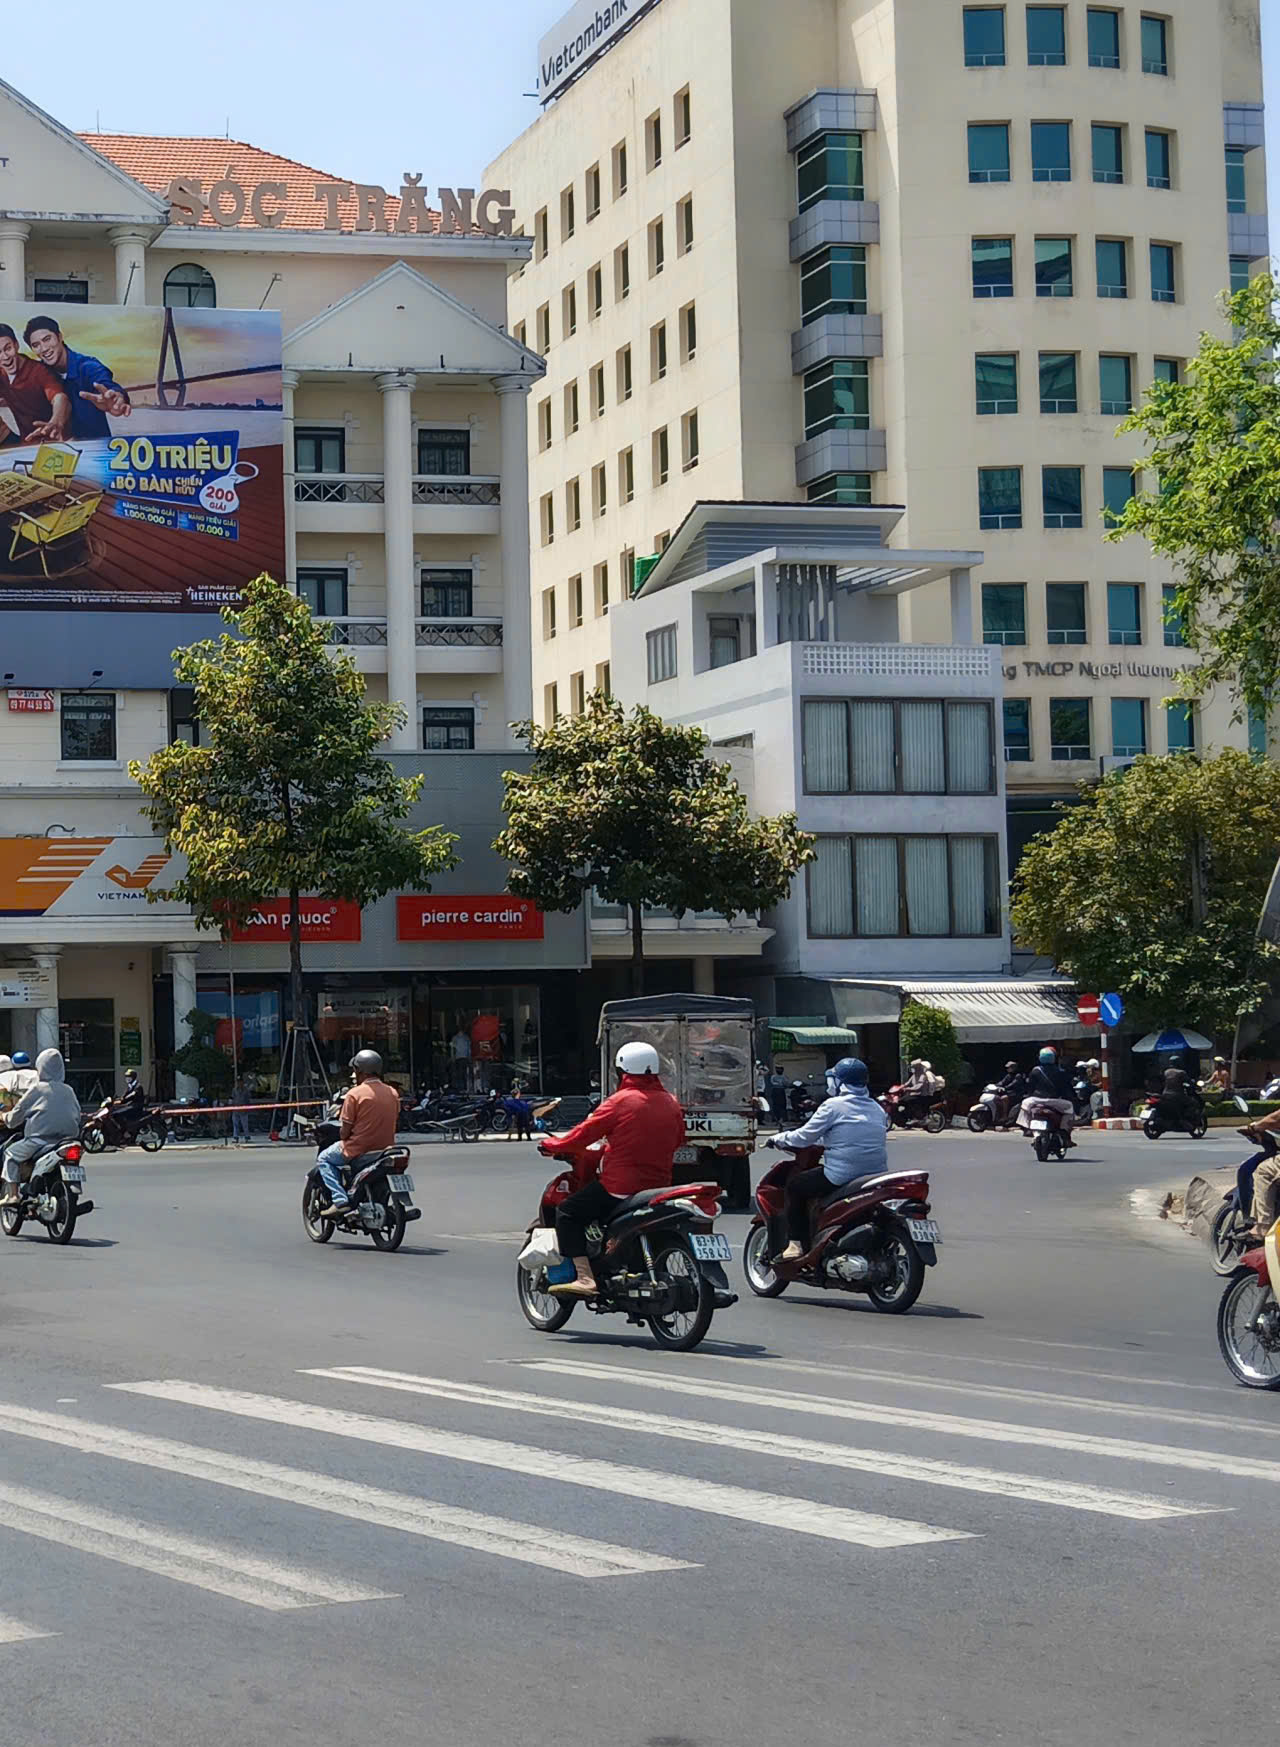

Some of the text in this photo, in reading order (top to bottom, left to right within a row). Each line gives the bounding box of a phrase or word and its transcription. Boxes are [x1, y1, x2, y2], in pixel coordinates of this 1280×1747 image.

[170, 165, 515, 234] SÓC TRĂNG
[109, 436, 232, 475] 20 TRIỆU
[115, 472, 173, 494] BỘ BÀN
[205, 485, 235, 502] 200
[124, 508, 165, 524] 1.000.000
[195, 523, 224, 536] 10.000
[190, 591, 243, 601] HEINEKEN
[1023, 661, 1073, 678] TMCP
[97, 892, 147, 900] VIETNAM
[281, 913, 331, 930] puoc
[422, 909, 523, 927] pierre cardin
[686, 1120, 712, 1131] UKI
